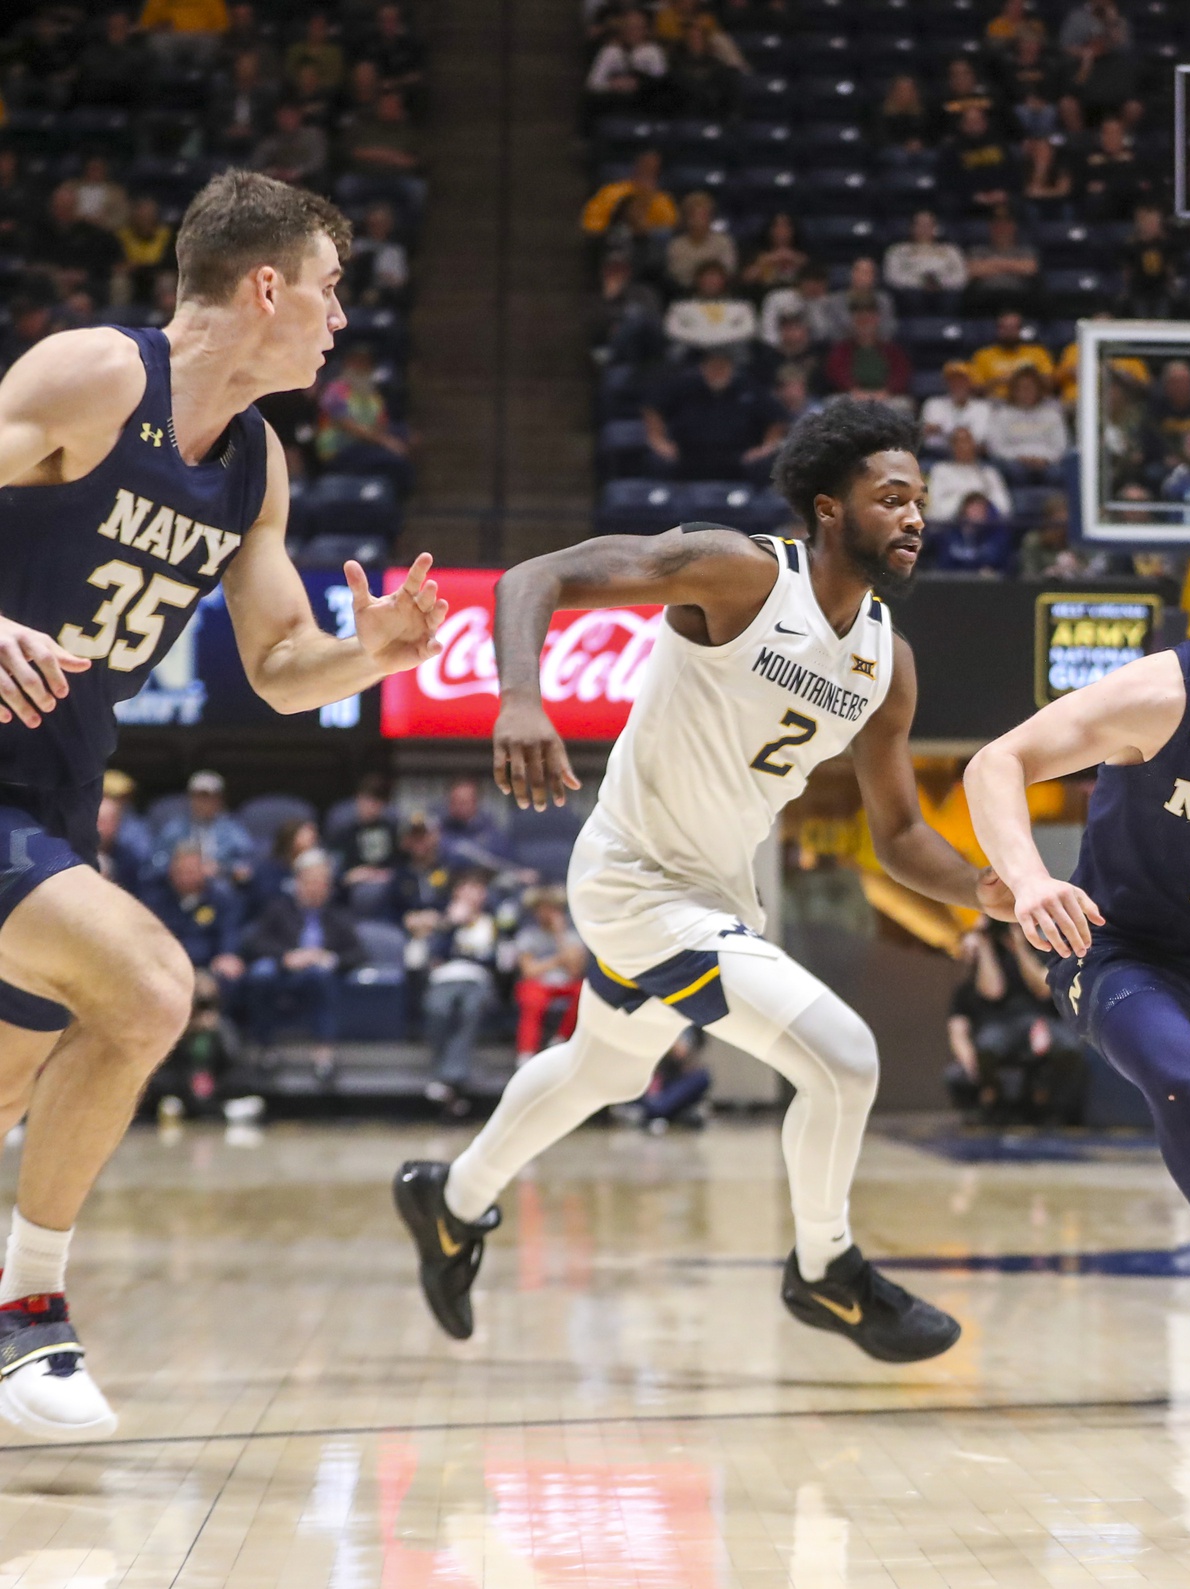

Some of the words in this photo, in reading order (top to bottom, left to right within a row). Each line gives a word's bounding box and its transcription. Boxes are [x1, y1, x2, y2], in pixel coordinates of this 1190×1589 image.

[97, 488, 242, 576] NAVY
[57, 559, 200, 672] 35
[1051, 621, 1146, 647] ARMY
[752, 647, 868, 721] MOUNTAINEERS
[750, 707, 818, 778] 2
